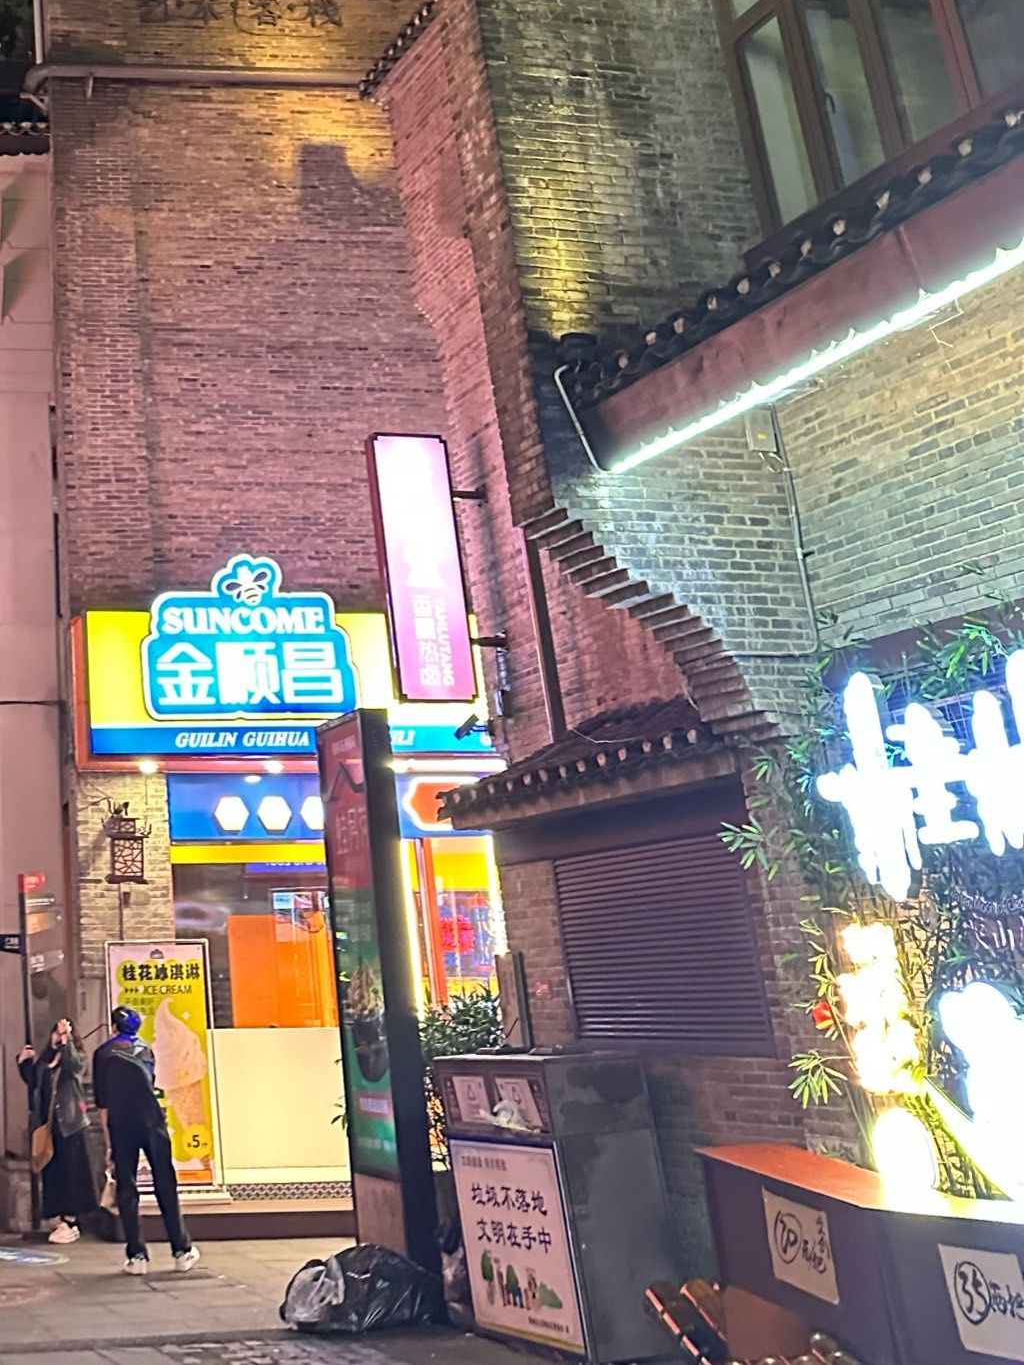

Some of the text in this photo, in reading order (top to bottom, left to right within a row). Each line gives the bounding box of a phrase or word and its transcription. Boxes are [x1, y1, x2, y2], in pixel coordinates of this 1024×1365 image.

[162, 607, 325, 635] SUNCOME
[156, 641, 345, 706] 金顺昌
[175, 731, 238, 748] GUILIN
[242, 731, 310, 748] GUIHUA
[122, 962, 201, 982] 桂花冰淇淋
[160, 985, 192, 995] CREAM
[471, 1182, 549, 1217] 垃圾不落地
[477, 1218, 553, 1254] 文明在手中
